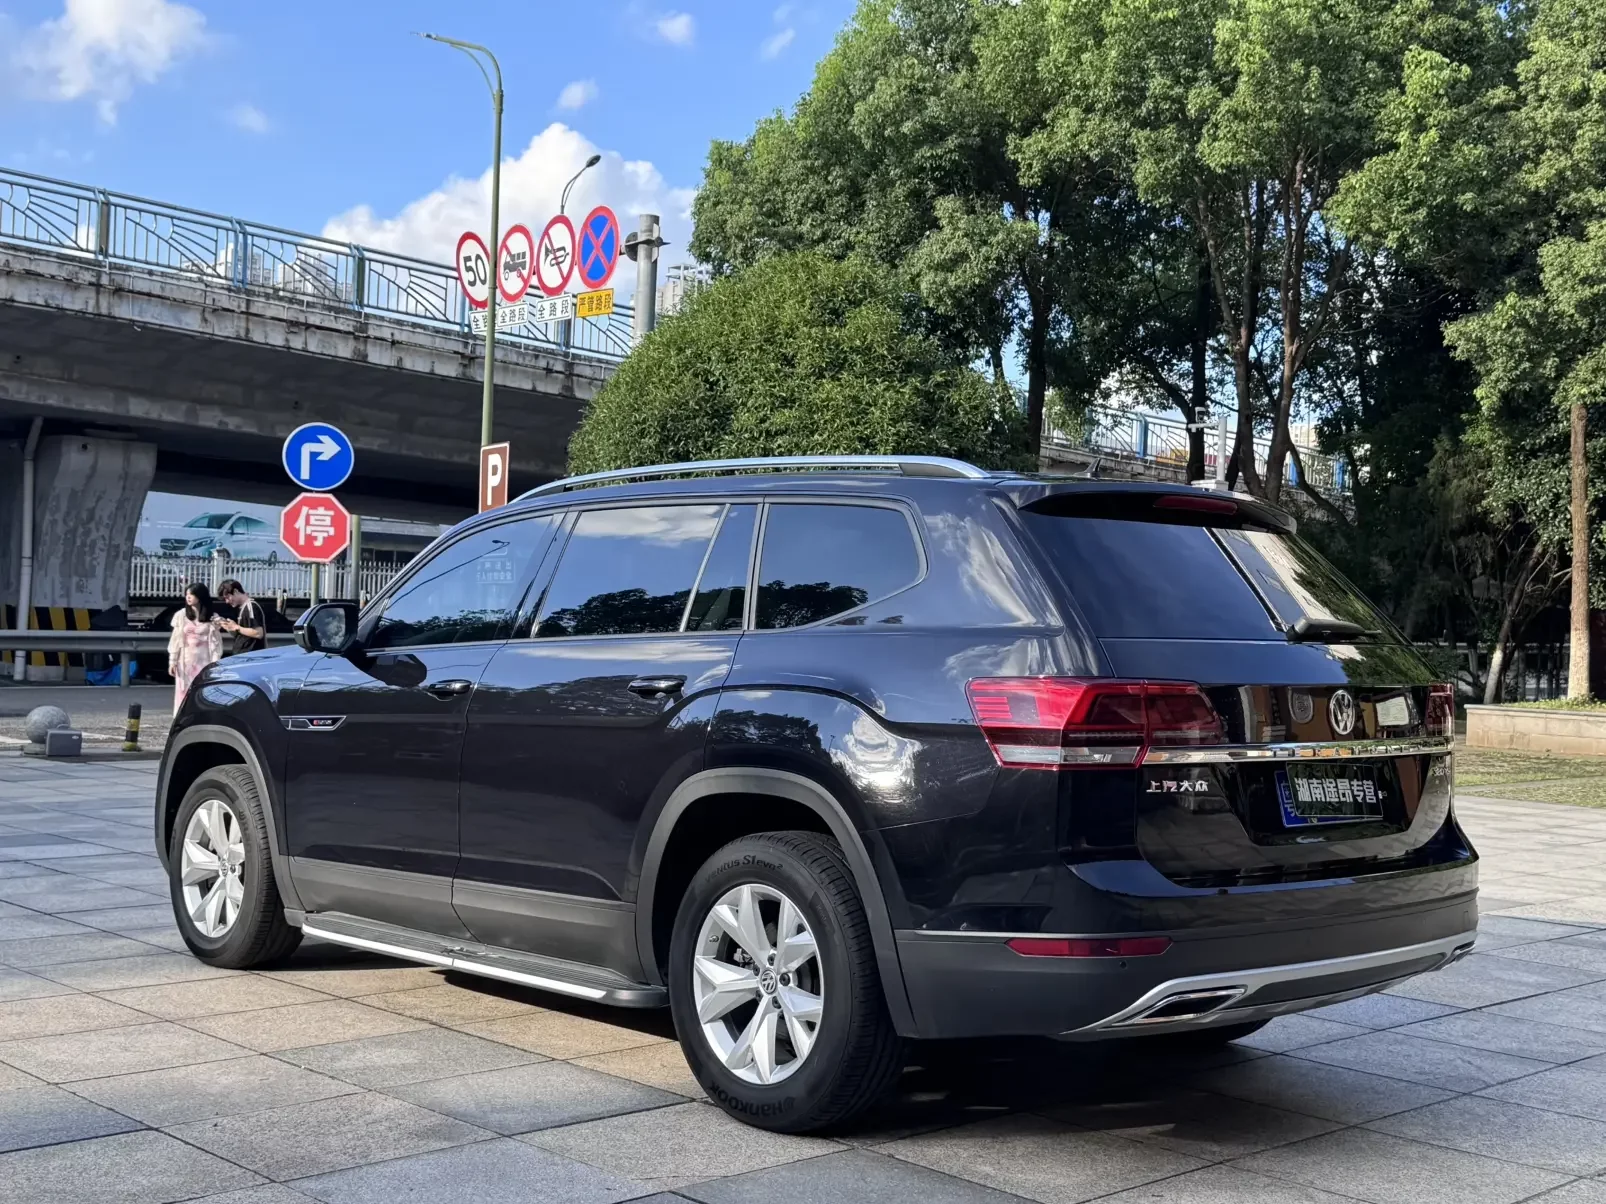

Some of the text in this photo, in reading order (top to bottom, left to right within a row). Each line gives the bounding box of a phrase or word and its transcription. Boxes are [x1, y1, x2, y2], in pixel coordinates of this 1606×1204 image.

[463, 254, 488, 287] 50
[499, 307, 526, 324] 全路段
[537, 299, 570, 320] 全路段
[486, 453, 502, 506] P
[294, 505, 335, 547] 停
[1145, 780, 1209, 793] 上汽大众
[1294, 777, 1377, 804] 湖南途昂专营
